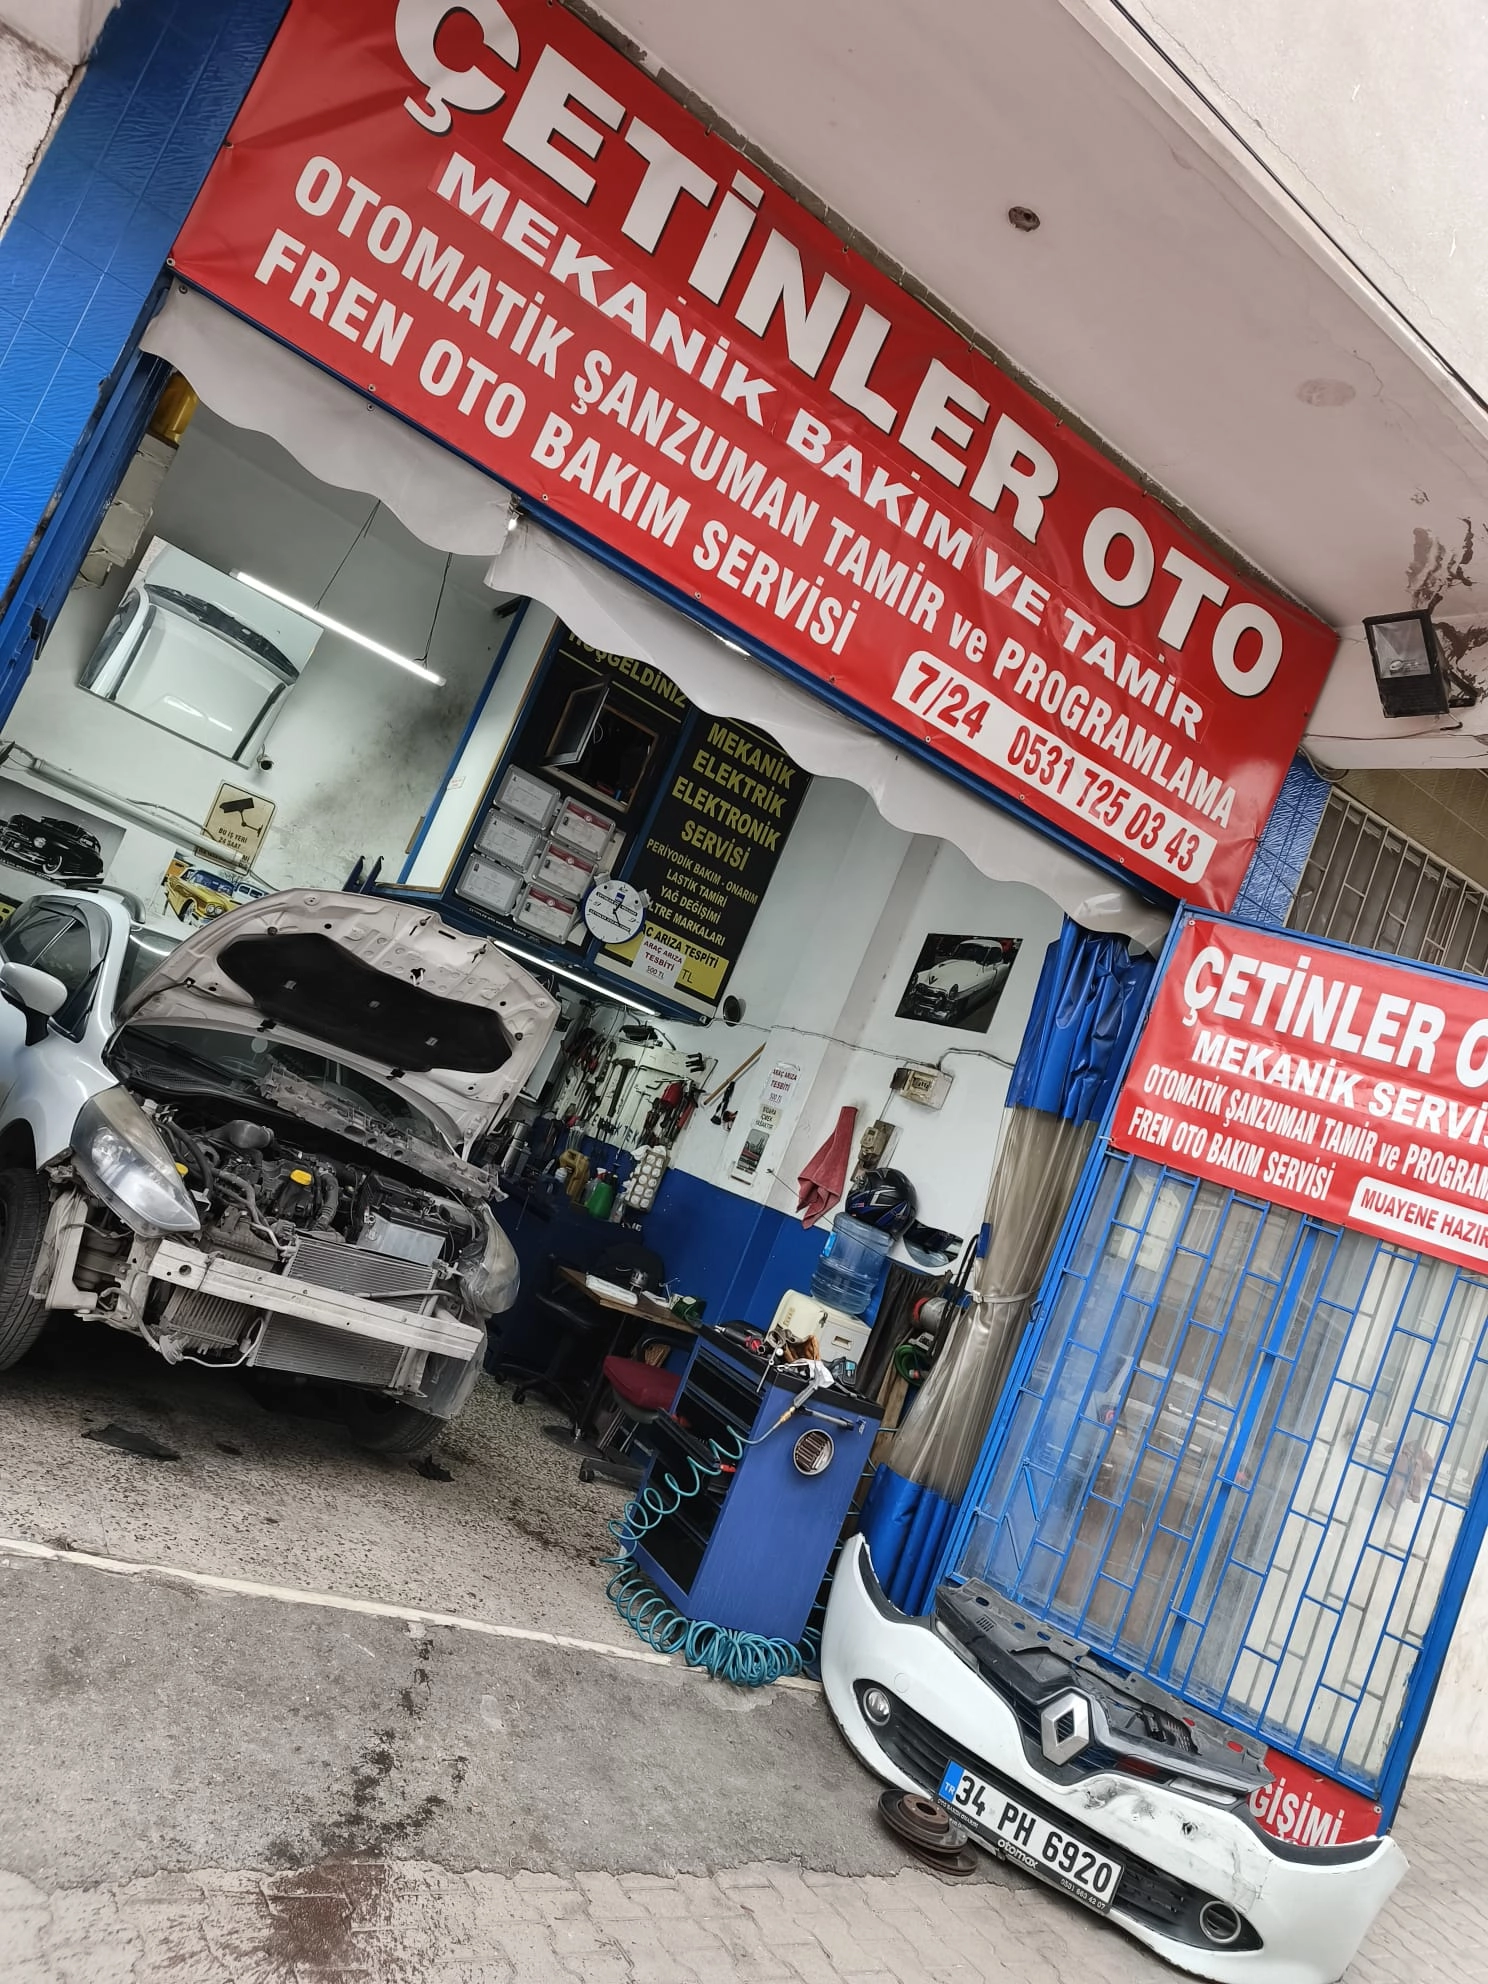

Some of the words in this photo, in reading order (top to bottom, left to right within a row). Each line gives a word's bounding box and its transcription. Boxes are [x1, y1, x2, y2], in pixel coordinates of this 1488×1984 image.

[395, 0, 1058, 543] ÇETİNLER
[1083, 506, 1282, 697] OTO
[255, 229, 413, 366] FREN
[419, 339, 526, 438] OTO
[531, 412, 690, 547] BAKIM
[693, 520, 861, 655] SERVİSİ
[437, 152, 776, 426] MEKANİK
[982, 546, 1050, 626] VE
[1063, 608, 1203, 741] TAMİR
[295, 156, 574, 378] OTOMATİK
[571, 350, 819, 547] ŞANZUMAN
[823, 516, 944, 632] TAMİR
[949, 613, 987, 662] ve
[993, 638, 1234, 829] PROGRAMLAMA
[692, 749, 787, 818] ELEKTRİK
[707, 722, 796, 790] MEKANİK
[910, 661, 989, 740] 7/24
[1008, 726, 1074, 793] 0531
[1083, 769, 1130, 827] 725
[1125, 804, 1165, 850] 03
[1165, 828, 1200, 872] 43
[671, 775, 782, 852] ELEKTRONİK
[681, 819, 751, 872] SERVİSİ
[646, 838, 695, 871] PERİYODİK
[692, 862, 722, 886] BAKIM
[725, 881, 759, 905] ONARIM
[660, 885, 680, 903] YAĞ
[679, 896, 722, 925] DEĞİŞİMİ
[666, 868, 699, 894] LASTİK
[698, 885, 728, 908] TAMİRİ
[643, 940, 662, 954] ARAÇ
[662, 950, 683, 964] ARIZA
[645, 951, 675, 972] TESBİTİ
[654, 929, 682, 952] ARIZA
[684, 944, 720, 969] TESPİTİ
[672, 912, 726, 947] MARKALARI
[681, 968, 694, 984] TL
[1182, 946, 1446, 1075] ÇETİNLER
[1143, 1064, 1229, 1116] OTOMATİK
[1223, 1089, 1320, 1145] ŞANZUMAN
[1321, 1117, 1379, 1164] TAMİR
[1378, 1143, 1401, 1172] ve
[1191, 1030, 1366, 1109] MEKANİK
[1368, 1081, 1488, 1149] SERVİ
[1127, 1106, 1174, 1149] FREN
[1171, 1122, 1209, 1159] OTO
[1206, 1132, 1270, 1178] BAKIM
[1262, 1151, 1337, 1201] SERVİSİ
[1360, 1187, 1438, 1231] MUAYENE
[944, 1781, 956, 1796] TR
[955, 1775, 986, 1817] 34
[997, 1801, 1037, 1847] PH
[1042, 1831, 1113, 1893] 6920
[997, 1838, 1039, 1870] otomax
